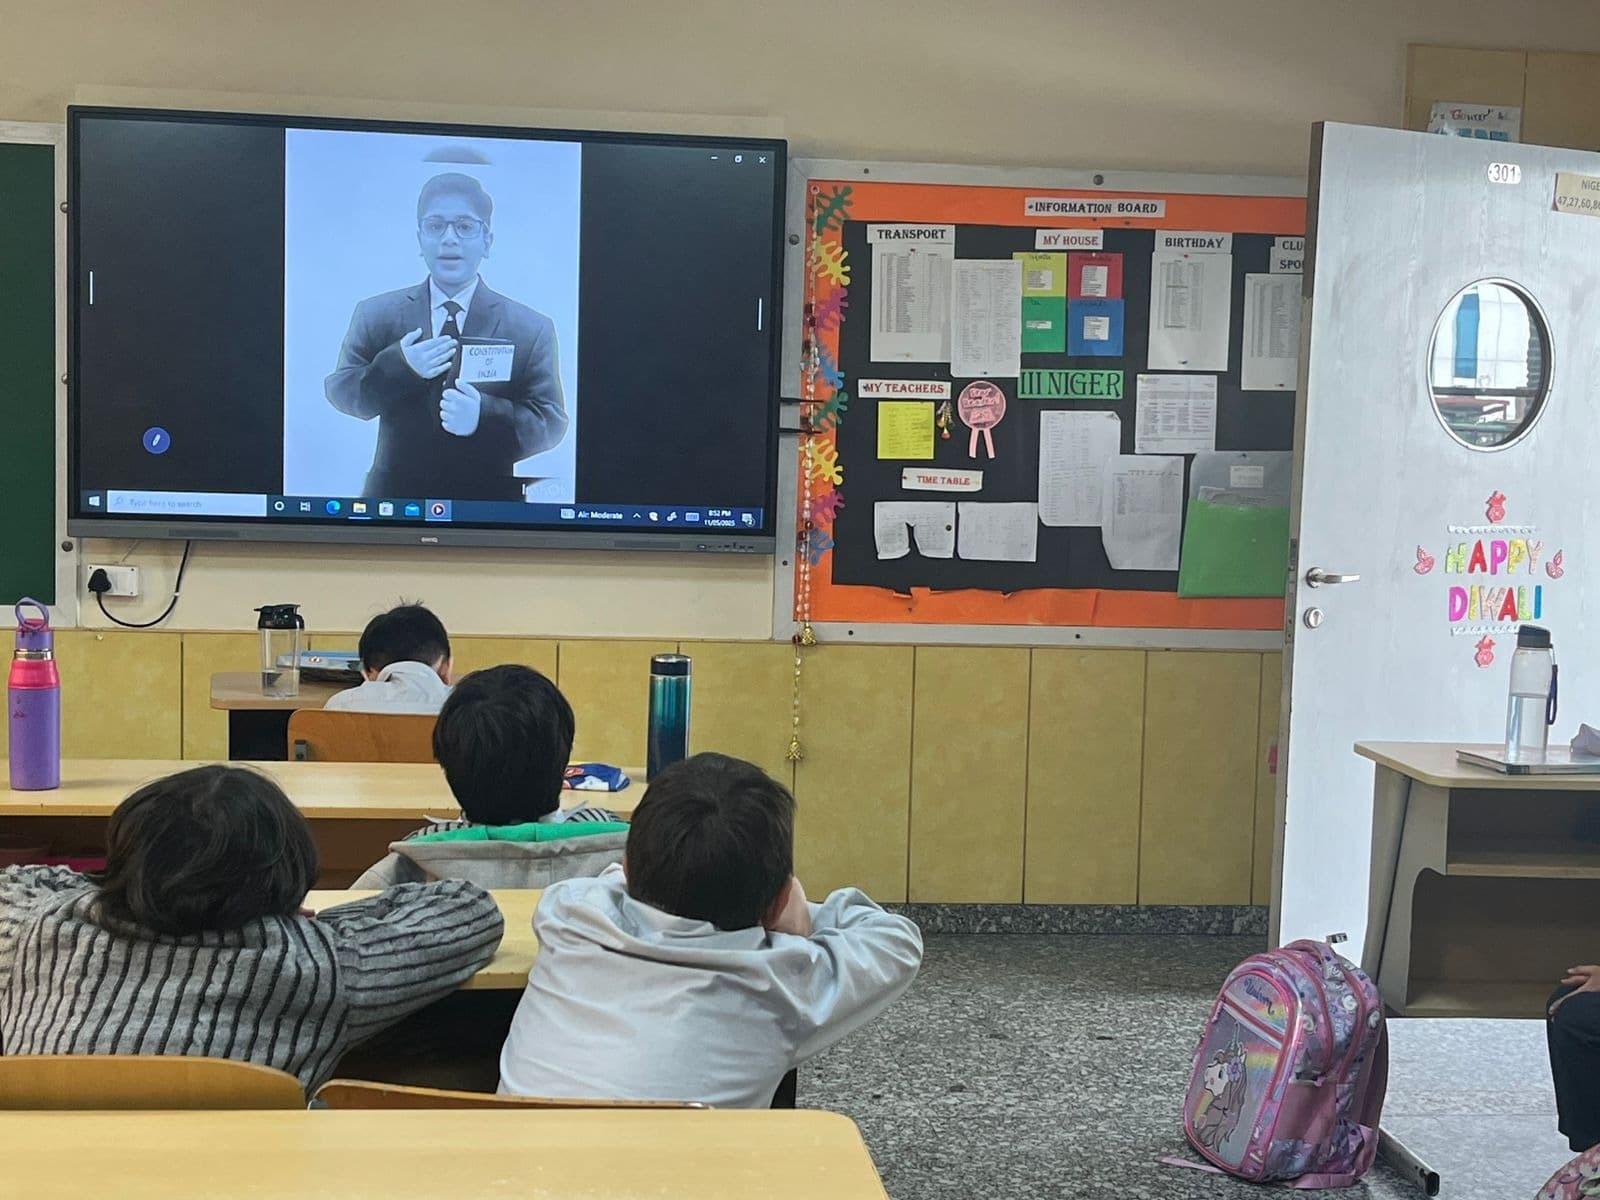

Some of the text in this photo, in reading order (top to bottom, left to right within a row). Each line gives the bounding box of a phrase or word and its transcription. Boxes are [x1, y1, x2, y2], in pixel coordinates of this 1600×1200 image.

[1493, 164, 1516, 182] 301
[1035, 202, 1158, 214] INFORMATION BOARD
[877, 229, 947, 240] TRANSPORT
[1043, 234, 1099, 246] MY HOUSE
[1165, 236, 1225, 249] BIRTHDAY
[865, 382, 945, 394] MY TEACHERS
[1020, 371, 1122, 398] III NIGER
[917, 475, 971, 486] TIME TABLE
[590, 512, 623, 520] Moderate
[1445, 539, 1543, 575] HAPPY
[1449, 584, 1542, 622] DIWALI
